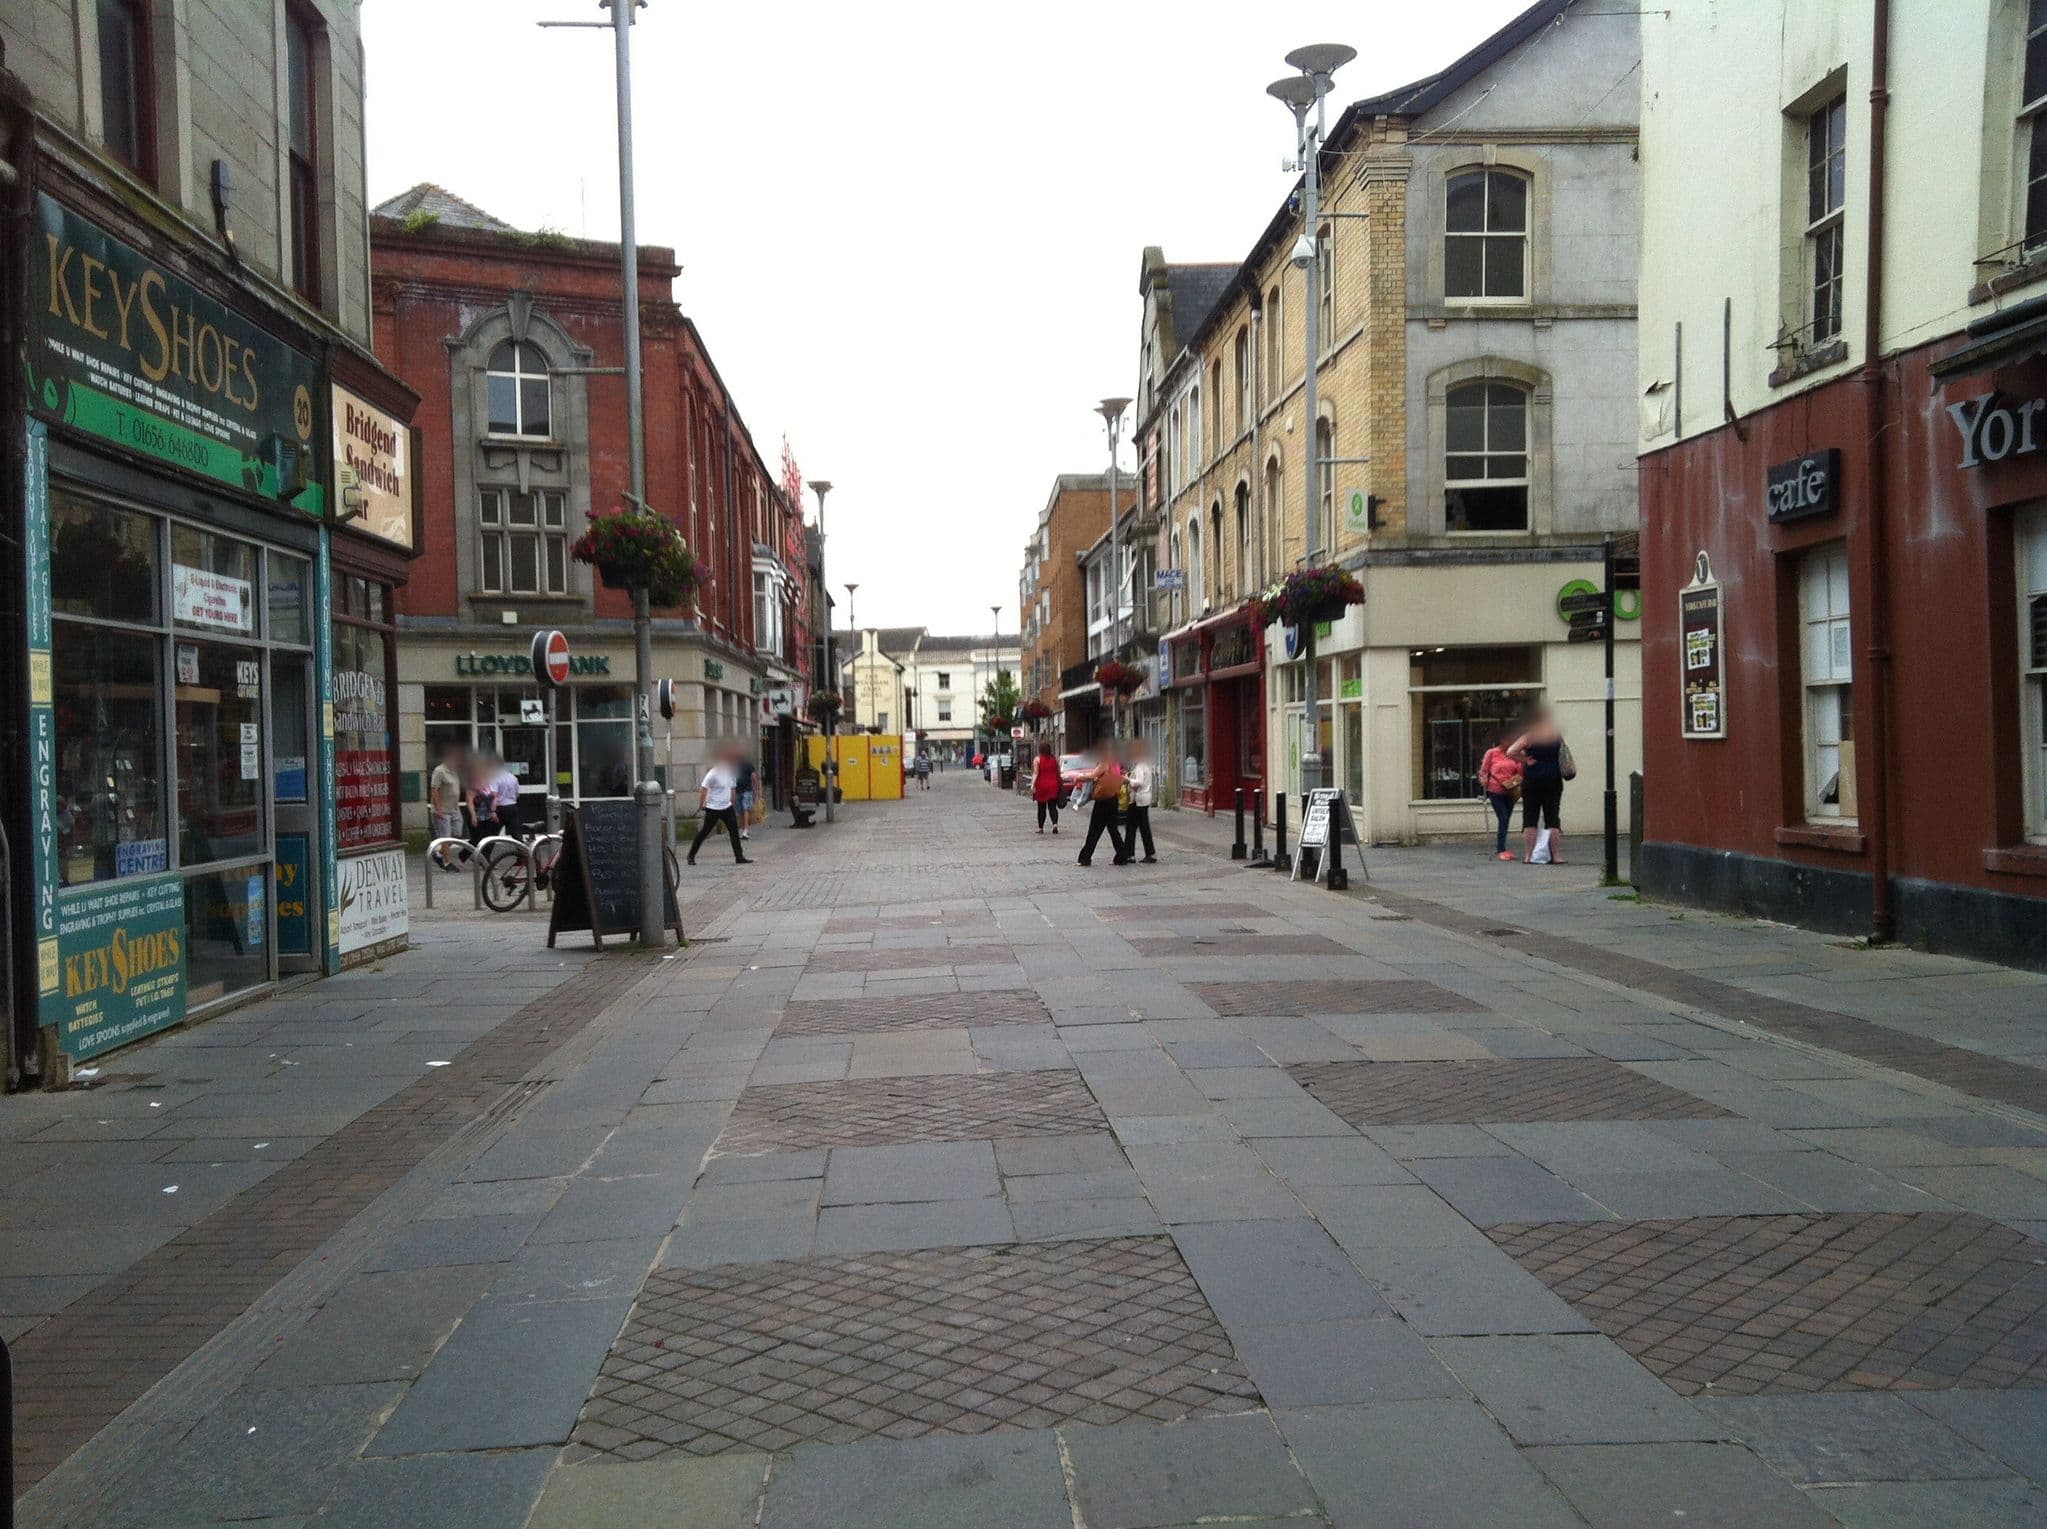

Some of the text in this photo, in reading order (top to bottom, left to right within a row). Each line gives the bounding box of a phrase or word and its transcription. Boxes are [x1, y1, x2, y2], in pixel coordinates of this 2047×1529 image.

[346, 401, 397, 459] Bridgend
[1946, 391, 2047, 469] Yor
[346, 443, 400, 497] Sandwich
[1767, 459, 1825, 516] cafe
[237, 660, 259, 685] KEYS
[456, 655, 610, 674] LLOYD ANK
[39, 714, 53, 931] ENGRAVING
[119, 852, 167, 875] CENTRE
[359, 884, 404, 912] TRAVEL
[80, 1032, 97, 1050] LOVE
[96, 1024, 121, 1044] SPOONS
